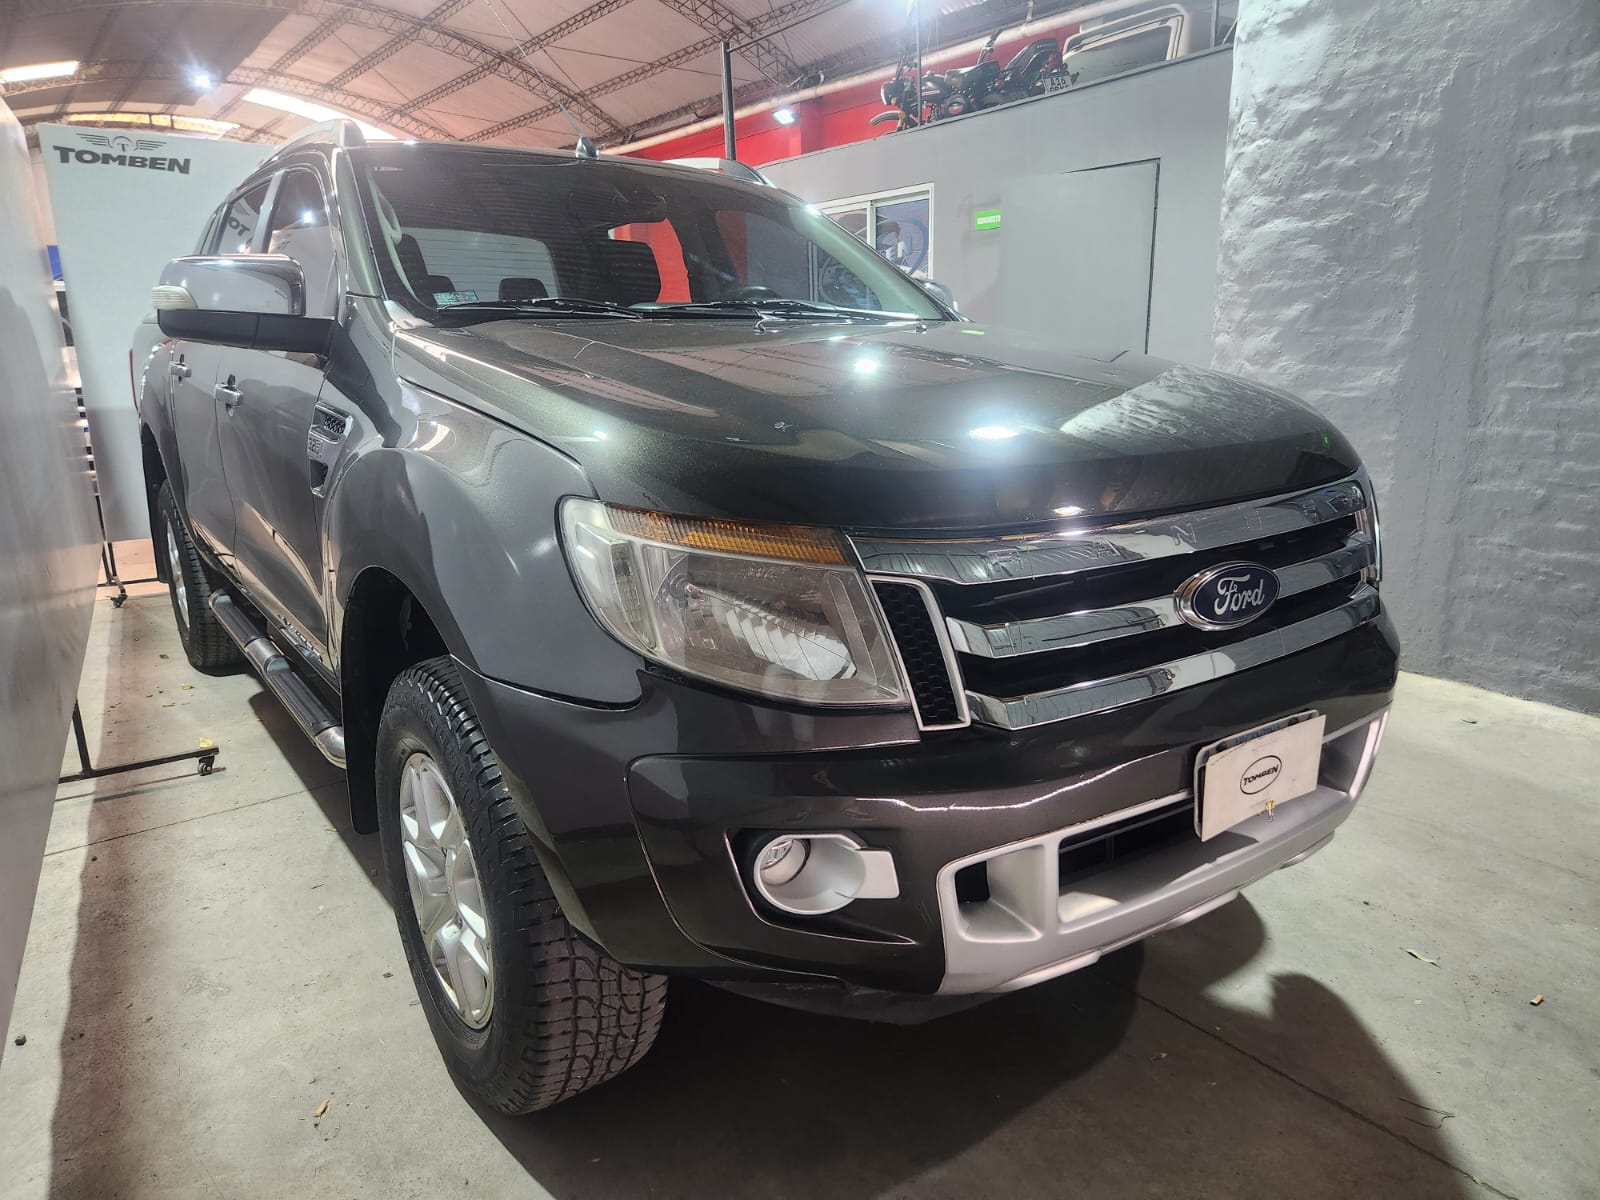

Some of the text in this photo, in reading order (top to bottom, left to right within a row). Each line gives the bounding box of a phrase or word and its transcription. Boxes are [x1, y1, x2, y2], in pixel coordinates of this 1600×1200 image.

[53, 145, 191, 175] TOMBEN
[1213, 574, 1265, 616] Ford
[1243, 764, 1279, 787] TOMBEN
